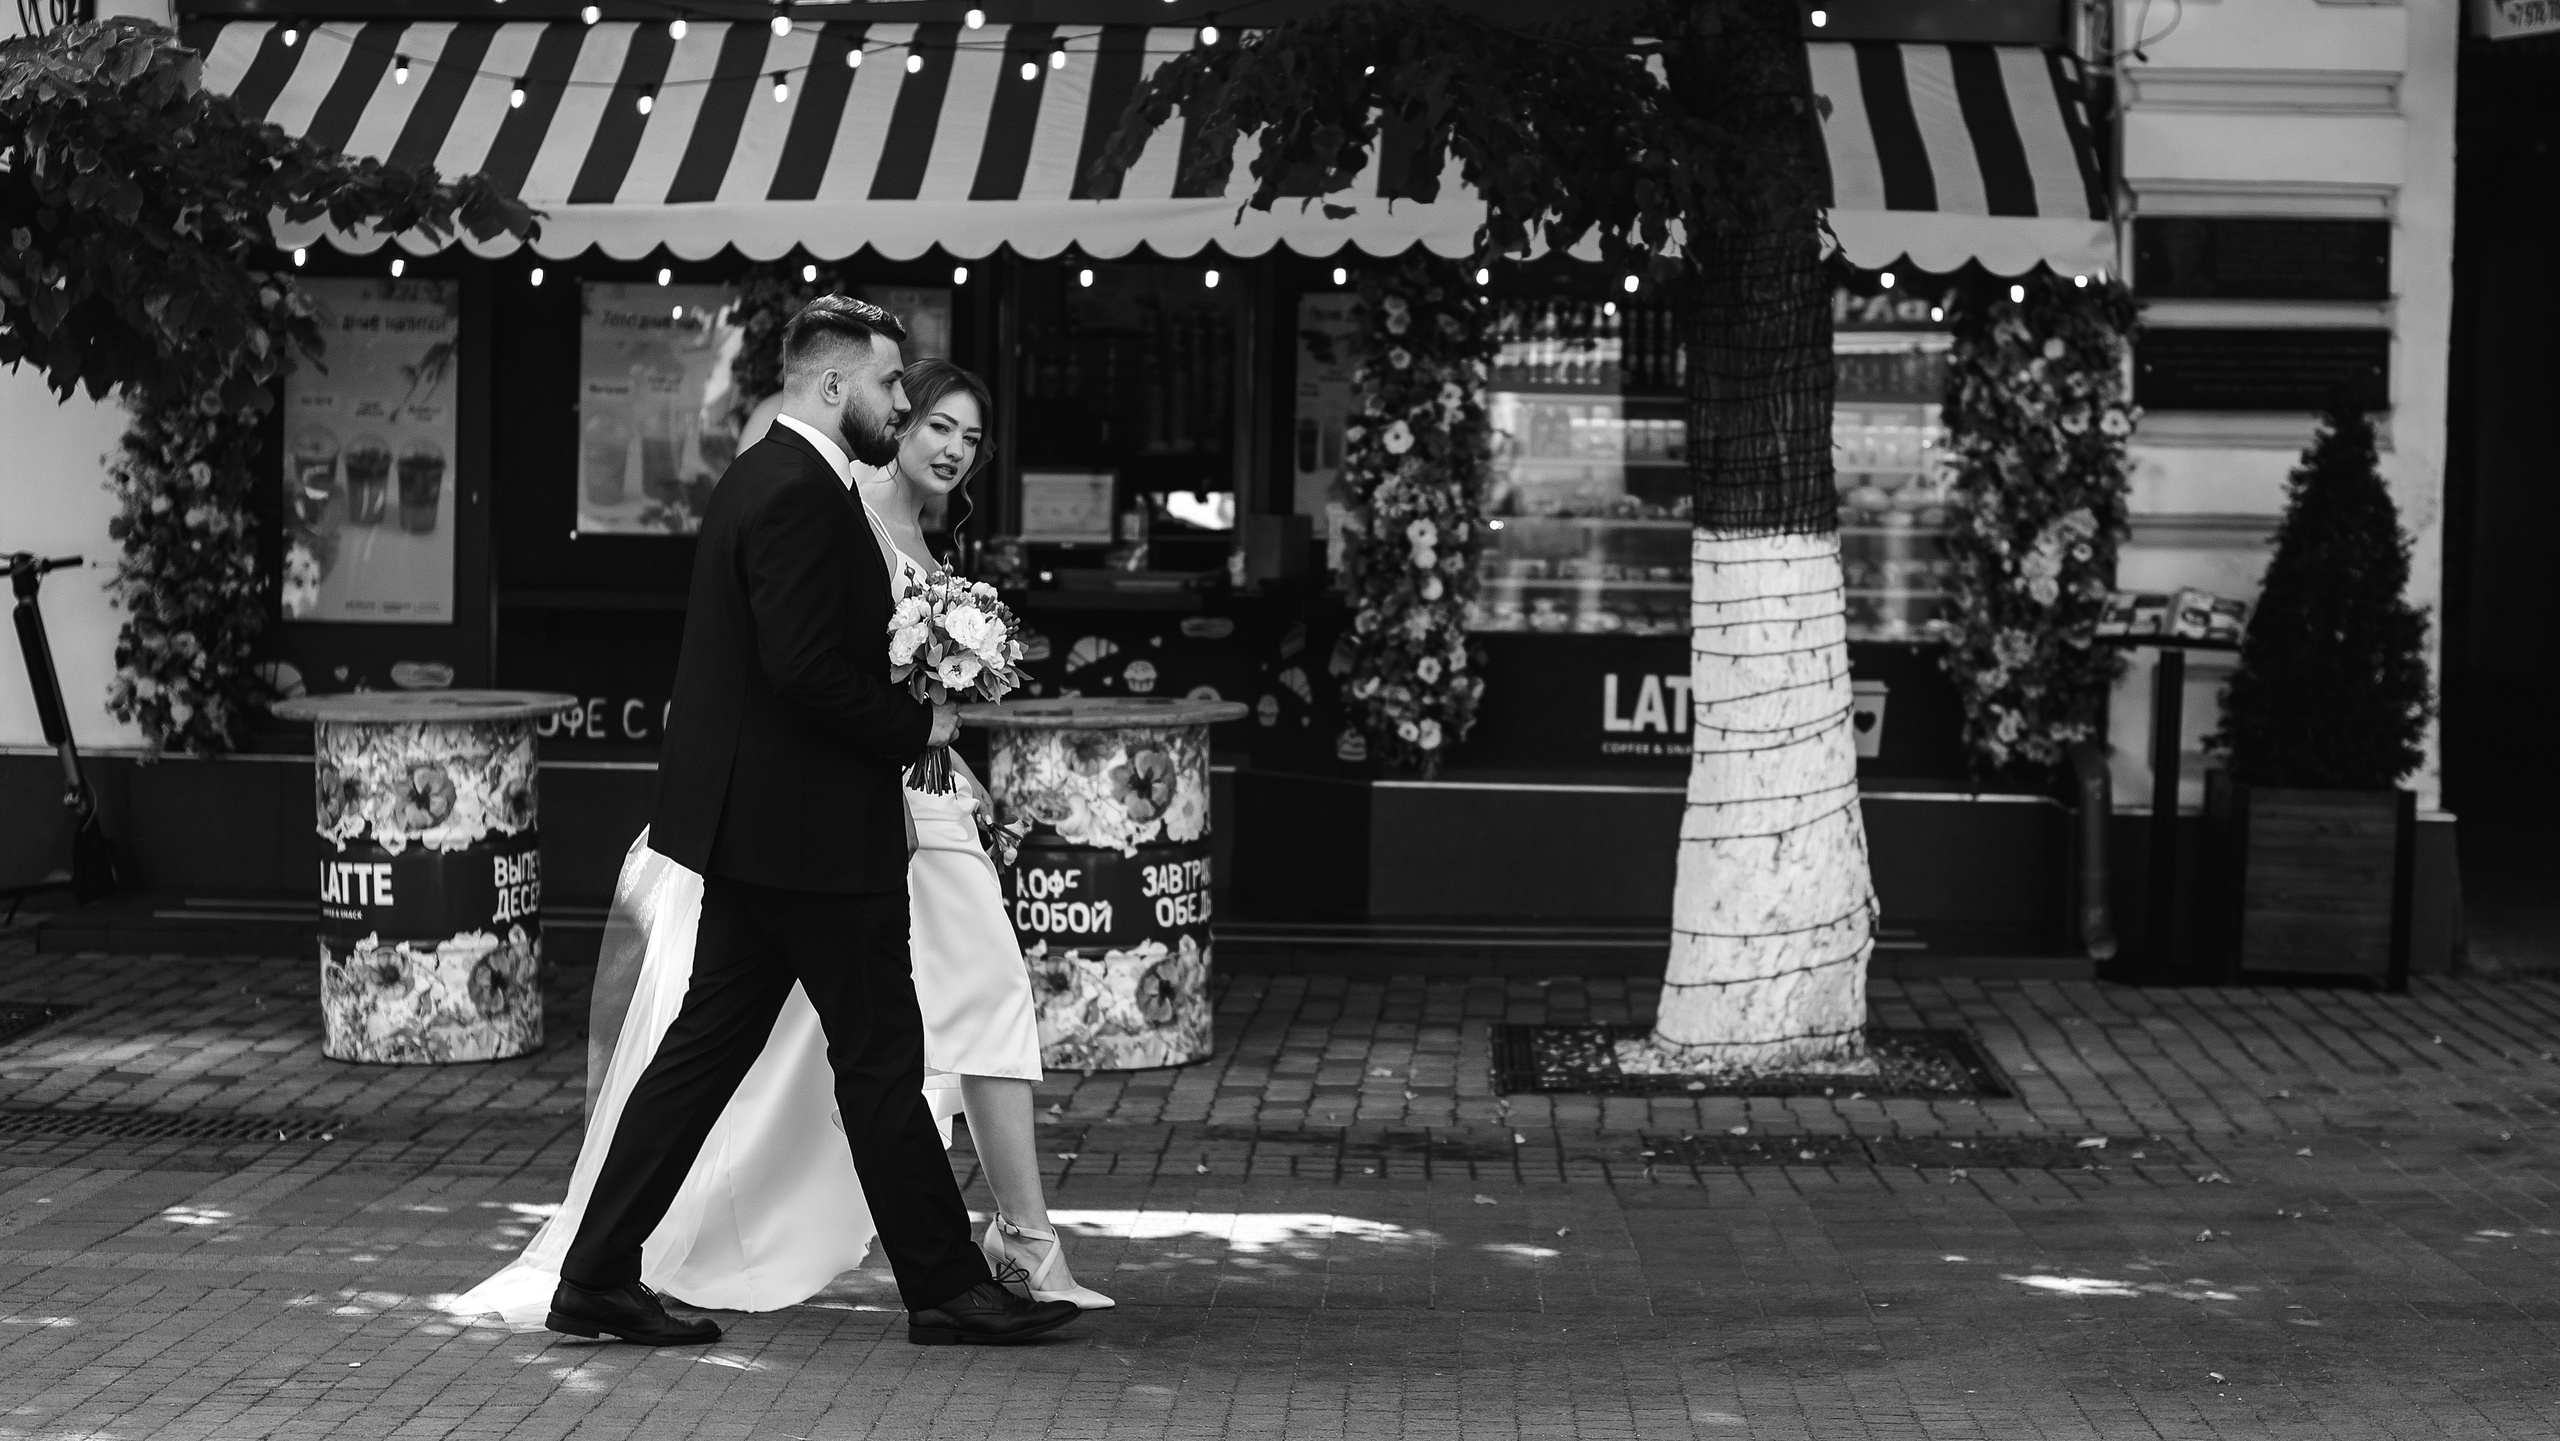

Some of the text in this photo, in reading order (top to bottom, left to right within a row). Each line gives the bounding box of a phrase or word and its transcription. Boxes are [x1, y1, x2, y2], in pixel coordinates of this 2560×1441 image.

[537, 698, 607, 738] ОФЕ
[1603, 673, 1695, 734] LAT
[320, 859, 394, 906] LATTE
[493, 850, 540, 888] ВЫПЕ
[1016, 899, 1113, 934] СОБОЙ
